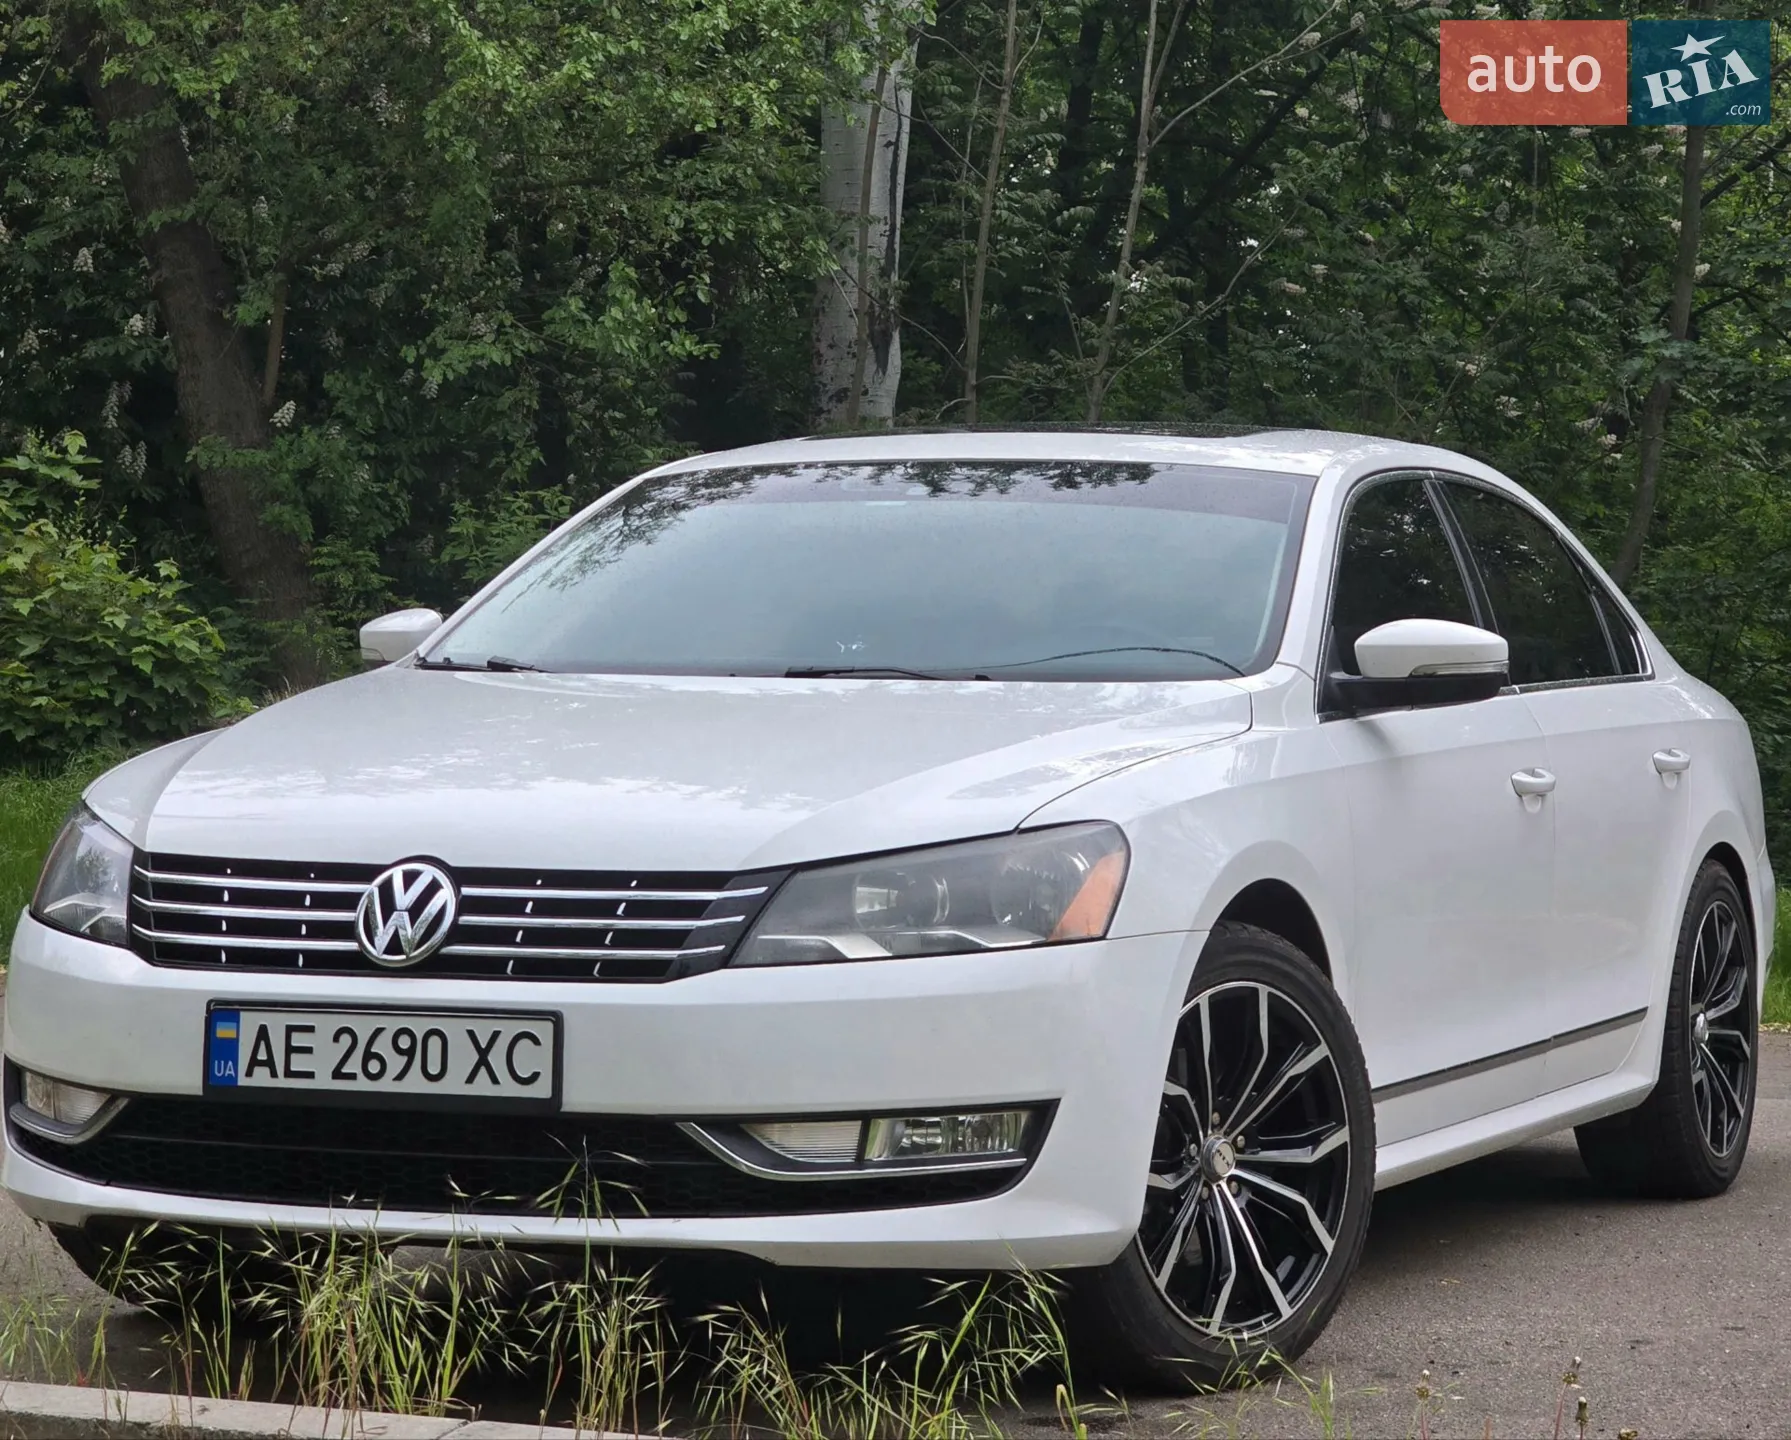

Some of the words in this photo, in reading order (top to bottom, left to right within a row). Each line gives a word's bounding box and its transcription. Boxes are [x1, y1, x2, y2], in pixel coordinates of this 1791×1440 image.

[213, 1059, 236, 1078] UA
[244, 1023, 316, 1079] AE
[331, 1025, 449, 1083] 2690
[464, 1028, 543, 1086] XC
